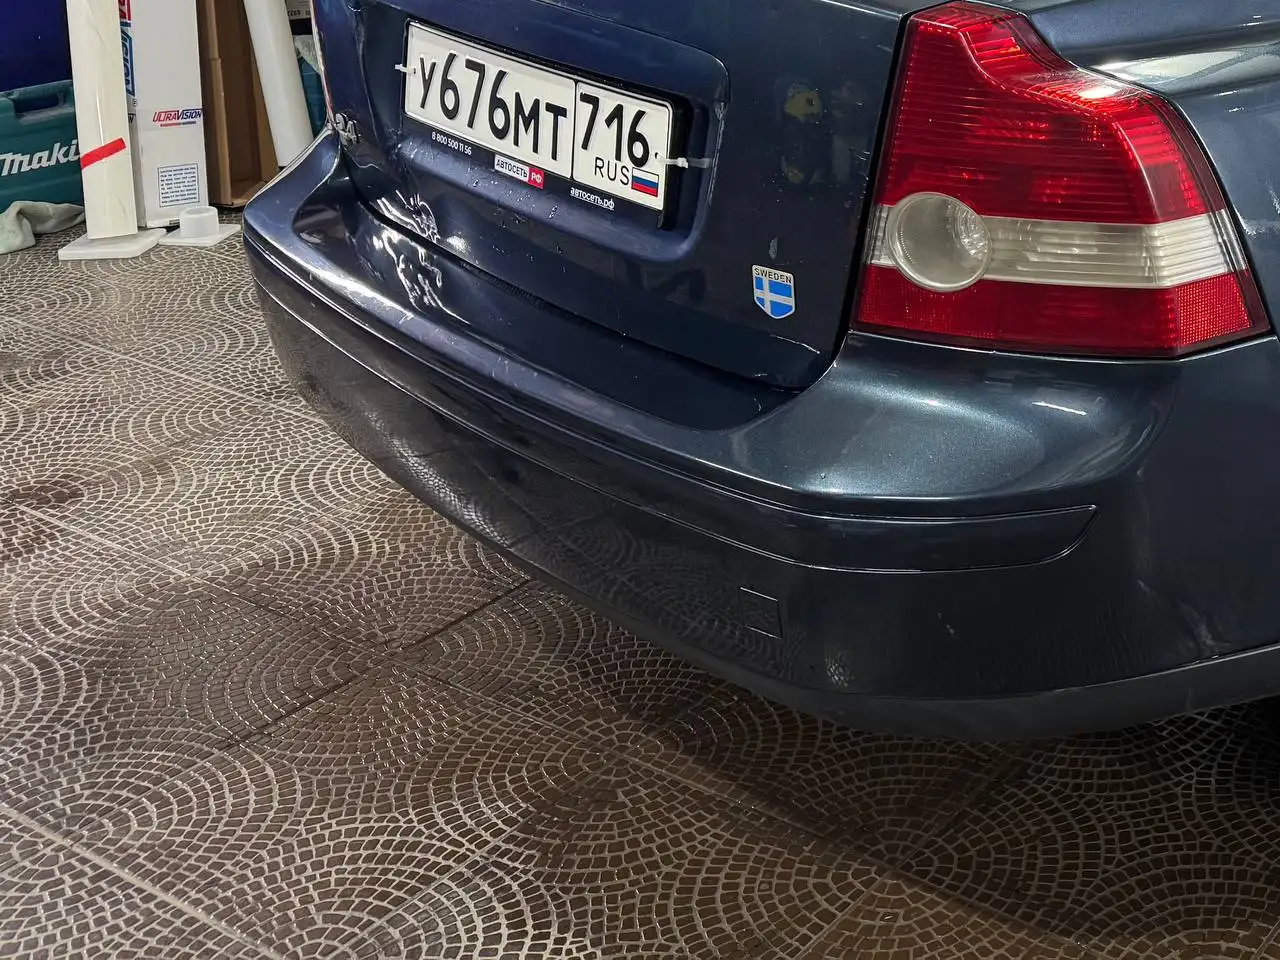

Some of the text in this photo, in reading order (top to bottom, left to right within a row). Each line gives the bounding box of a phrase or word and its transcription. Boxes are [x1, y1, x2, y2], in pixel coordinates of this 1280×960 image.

[152, 107, 203, 123] ULTRAVISION
[578, 90, 651, 168] 716
[0, 138, 80, 177] Maki
[436, 133, 448, 146] 800
[447, 136, 459, 150] 500
[464, 145, 472, 156] 56
[495, 158, 543, 185] АВТОСЕТЬ РФ
[594, 156, 630, 186] RUS
[570, 186, 616, 211] автосеть.рф
[754, 267, 792, 284] SWEDEN
